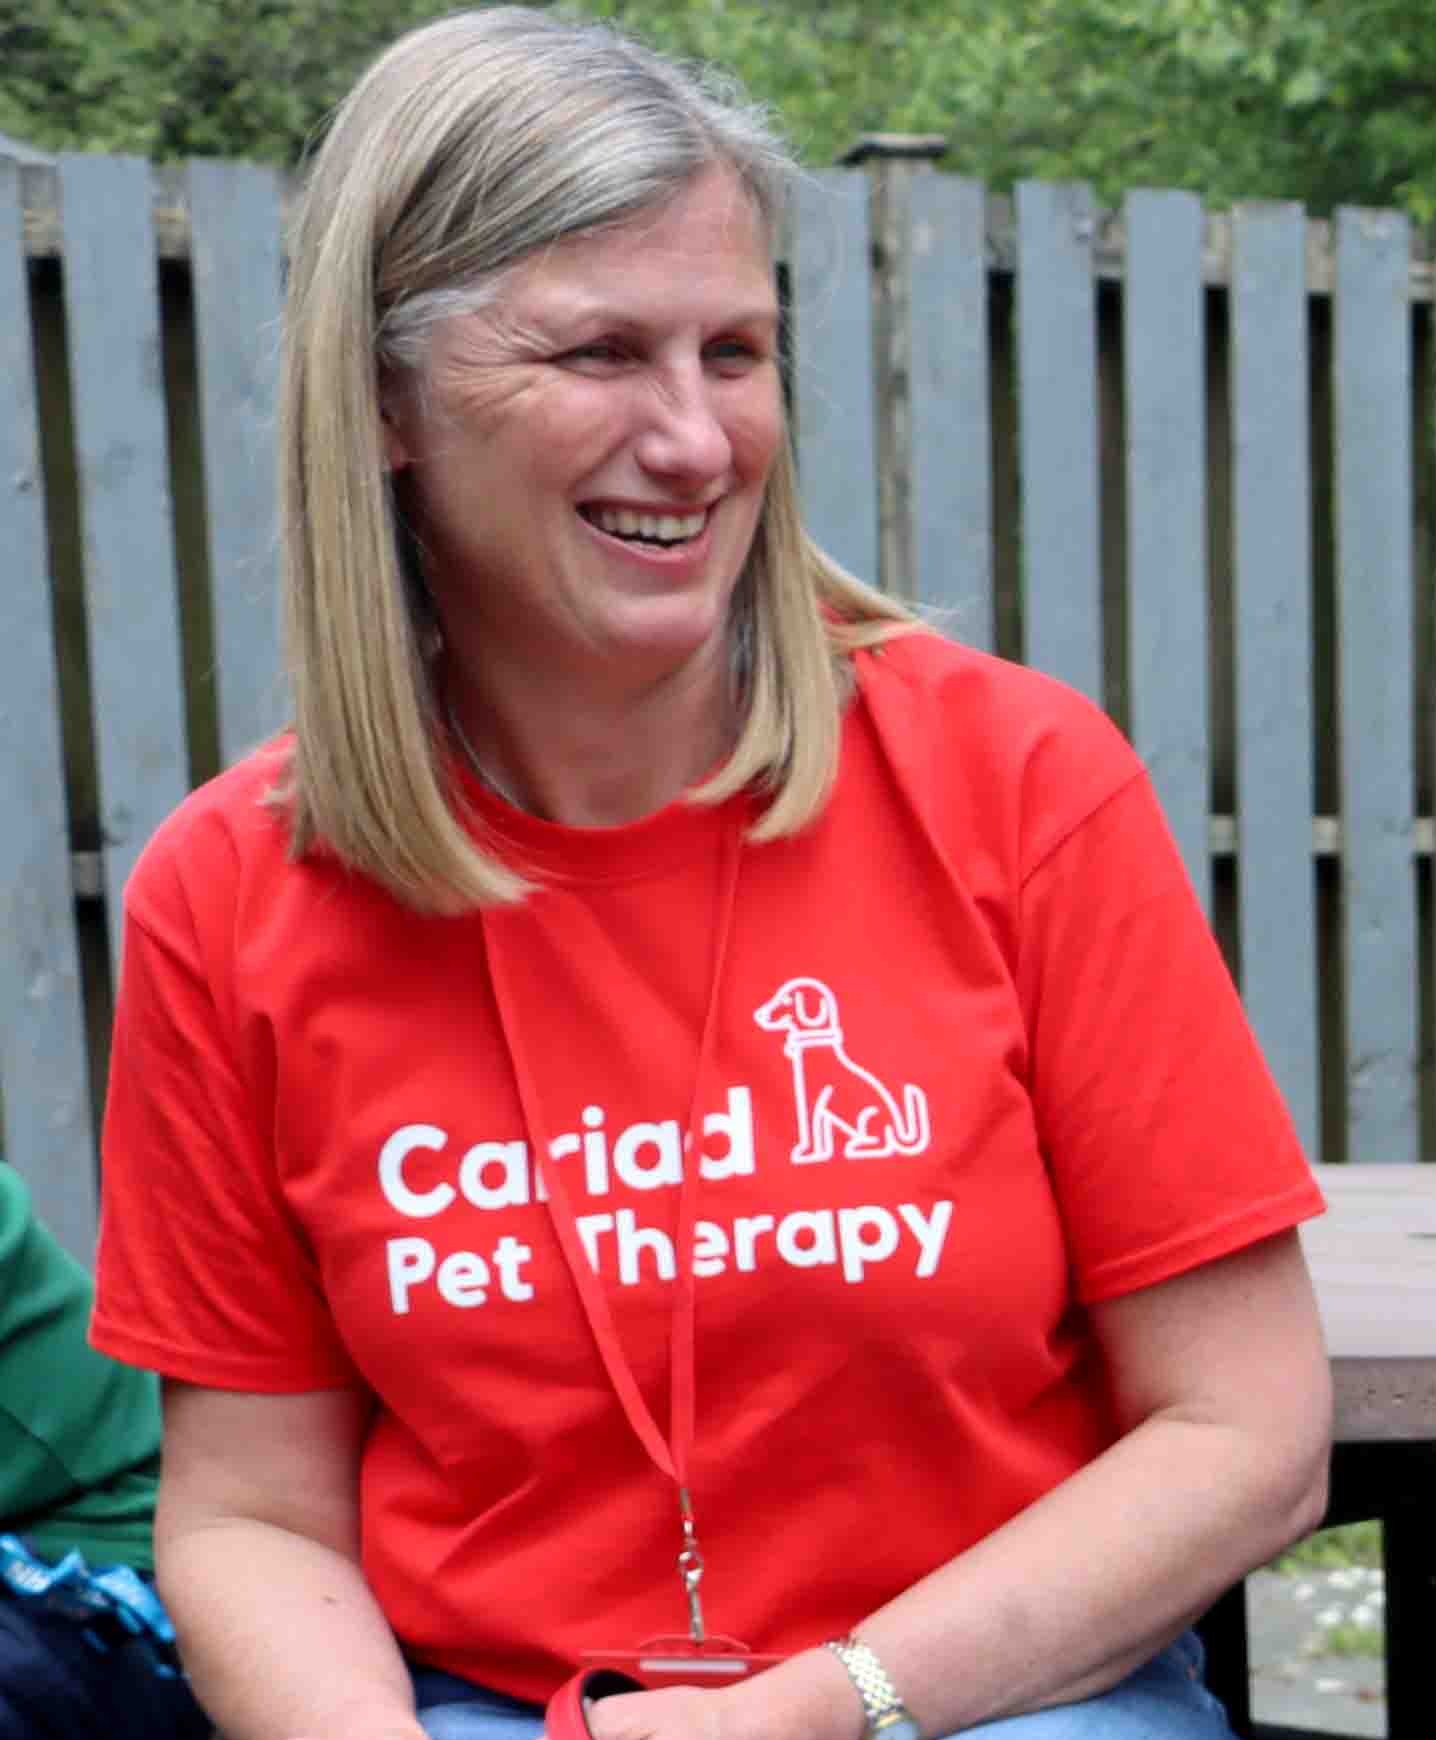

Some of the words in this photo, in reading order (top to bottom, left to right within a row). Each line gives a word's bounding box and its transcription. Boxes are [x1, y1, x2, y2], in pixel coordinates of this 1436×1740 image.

[378, 1084, 757, 1218] Cariad
[385, 1235, 535, 1315] Pet
[574, 1200, 954, 1286] Therapy
